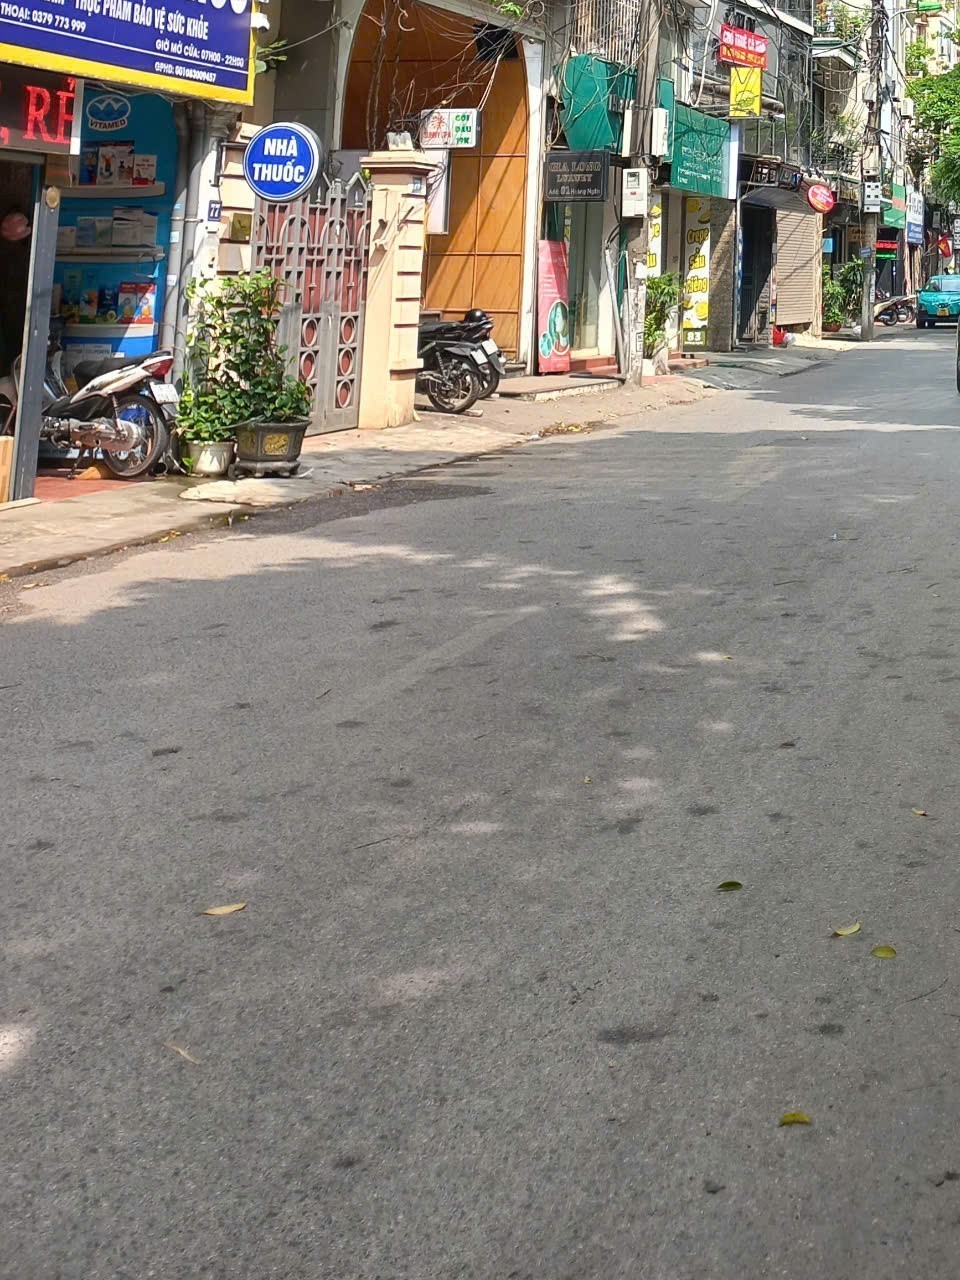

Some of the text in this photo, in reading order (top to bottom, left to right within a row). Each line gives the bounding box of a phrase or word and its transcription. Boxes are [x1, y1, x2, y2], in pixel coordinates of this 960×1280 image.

[32, 9, 54, 26] 0379
[54, 14, 70, 30] 773
[71, 18, 87, 33] 999
[133, 0, 153, 27] BẢO
[154, 6, 166, 34] VỆ
[167, 10, 185, 35] SỨC
[90, 118, 127, 130] VITAMED
[263, 135, 298, 157] NHÀ
[252, 159, 305, 183] THUỐC
[210, 203, 221, 218] 77
[687, 331, 702, 342] 83
